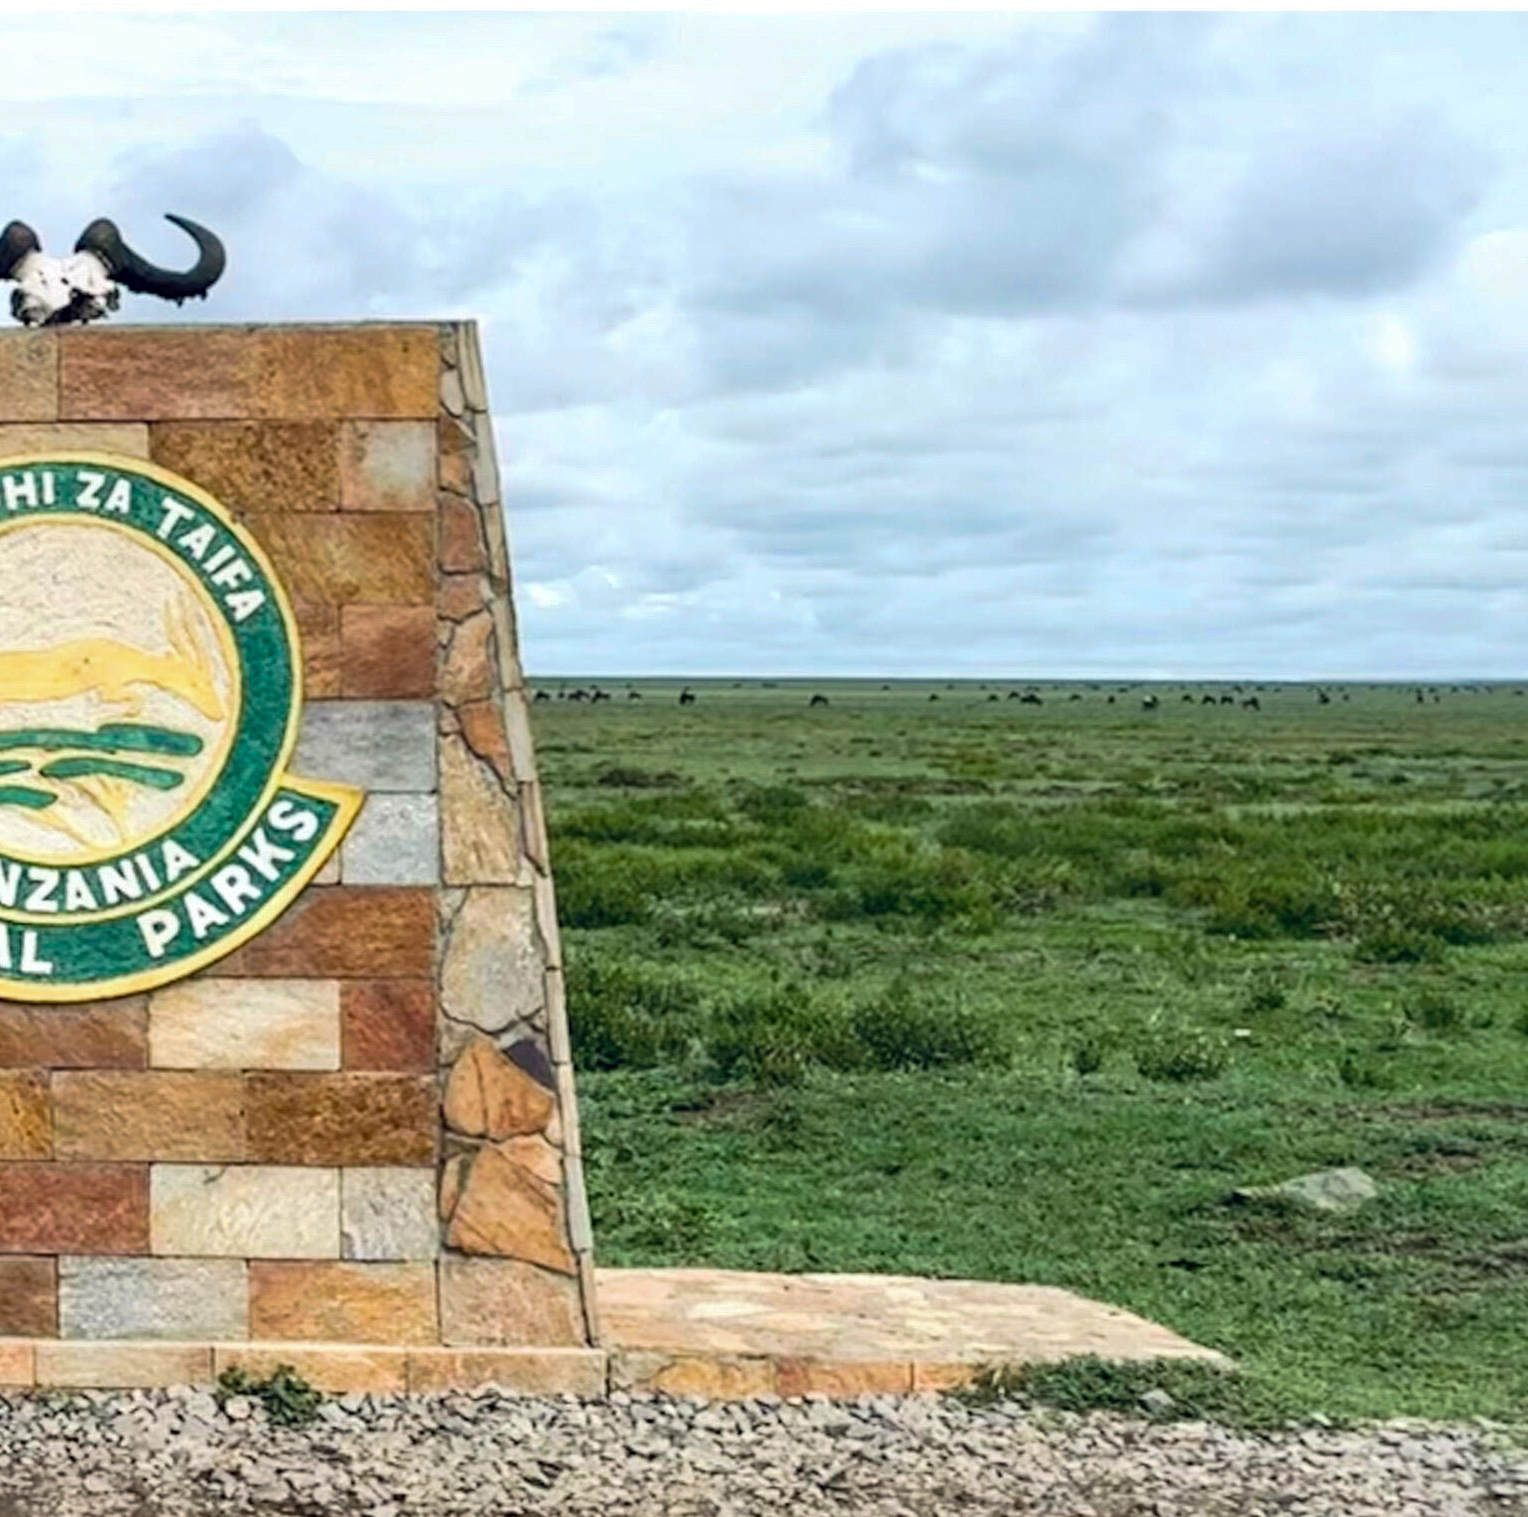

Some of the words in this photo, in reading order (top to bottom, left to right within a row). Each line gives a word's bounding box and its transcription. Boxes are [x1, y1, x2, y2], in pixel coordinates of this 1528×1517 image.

[75, 471, 131, 514] ZA
[156, 497, 266, 621] TAIFA
[136, 800, 319, 958] PARKS
